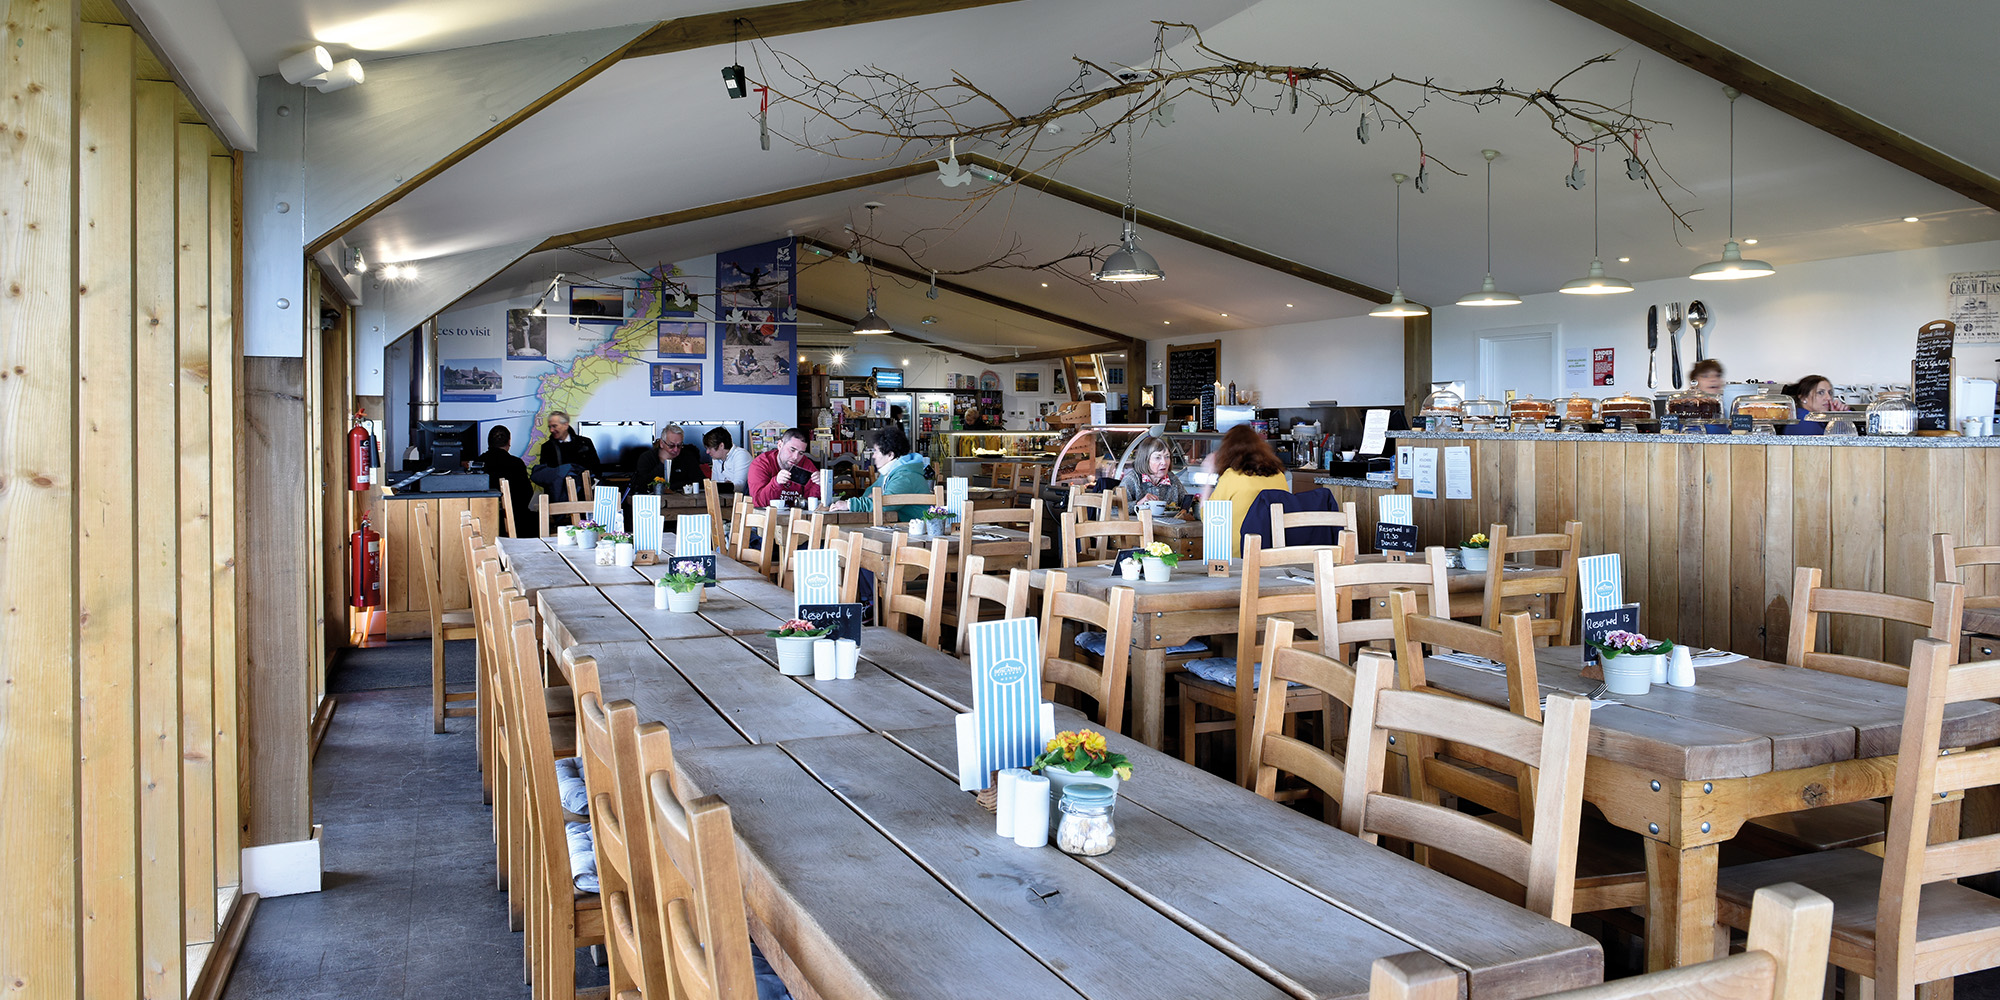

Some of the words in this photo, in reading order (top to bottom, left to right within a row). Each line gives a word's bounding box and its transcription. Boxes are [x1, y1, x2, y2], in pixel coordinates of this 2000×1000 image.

[1949, 281, 1977, 295] CREAM
[1980, 279, 2000, 293] TEAS
[437, 327, 454, 336] ces
[456, 328, 468, 336] to
[470, 326, 491, 337] visit
[706, 558, 712, 567] 5
[1214, 564, 1224, 572] 12
[801, 606, 841, 620] Reserved
[846, 608, 852, 619] 4
[1586, 612, 1617, 630] Reserved
[1623, 613, 1630, 623] 13
[1593, 630, 1608, 641] 12.3
